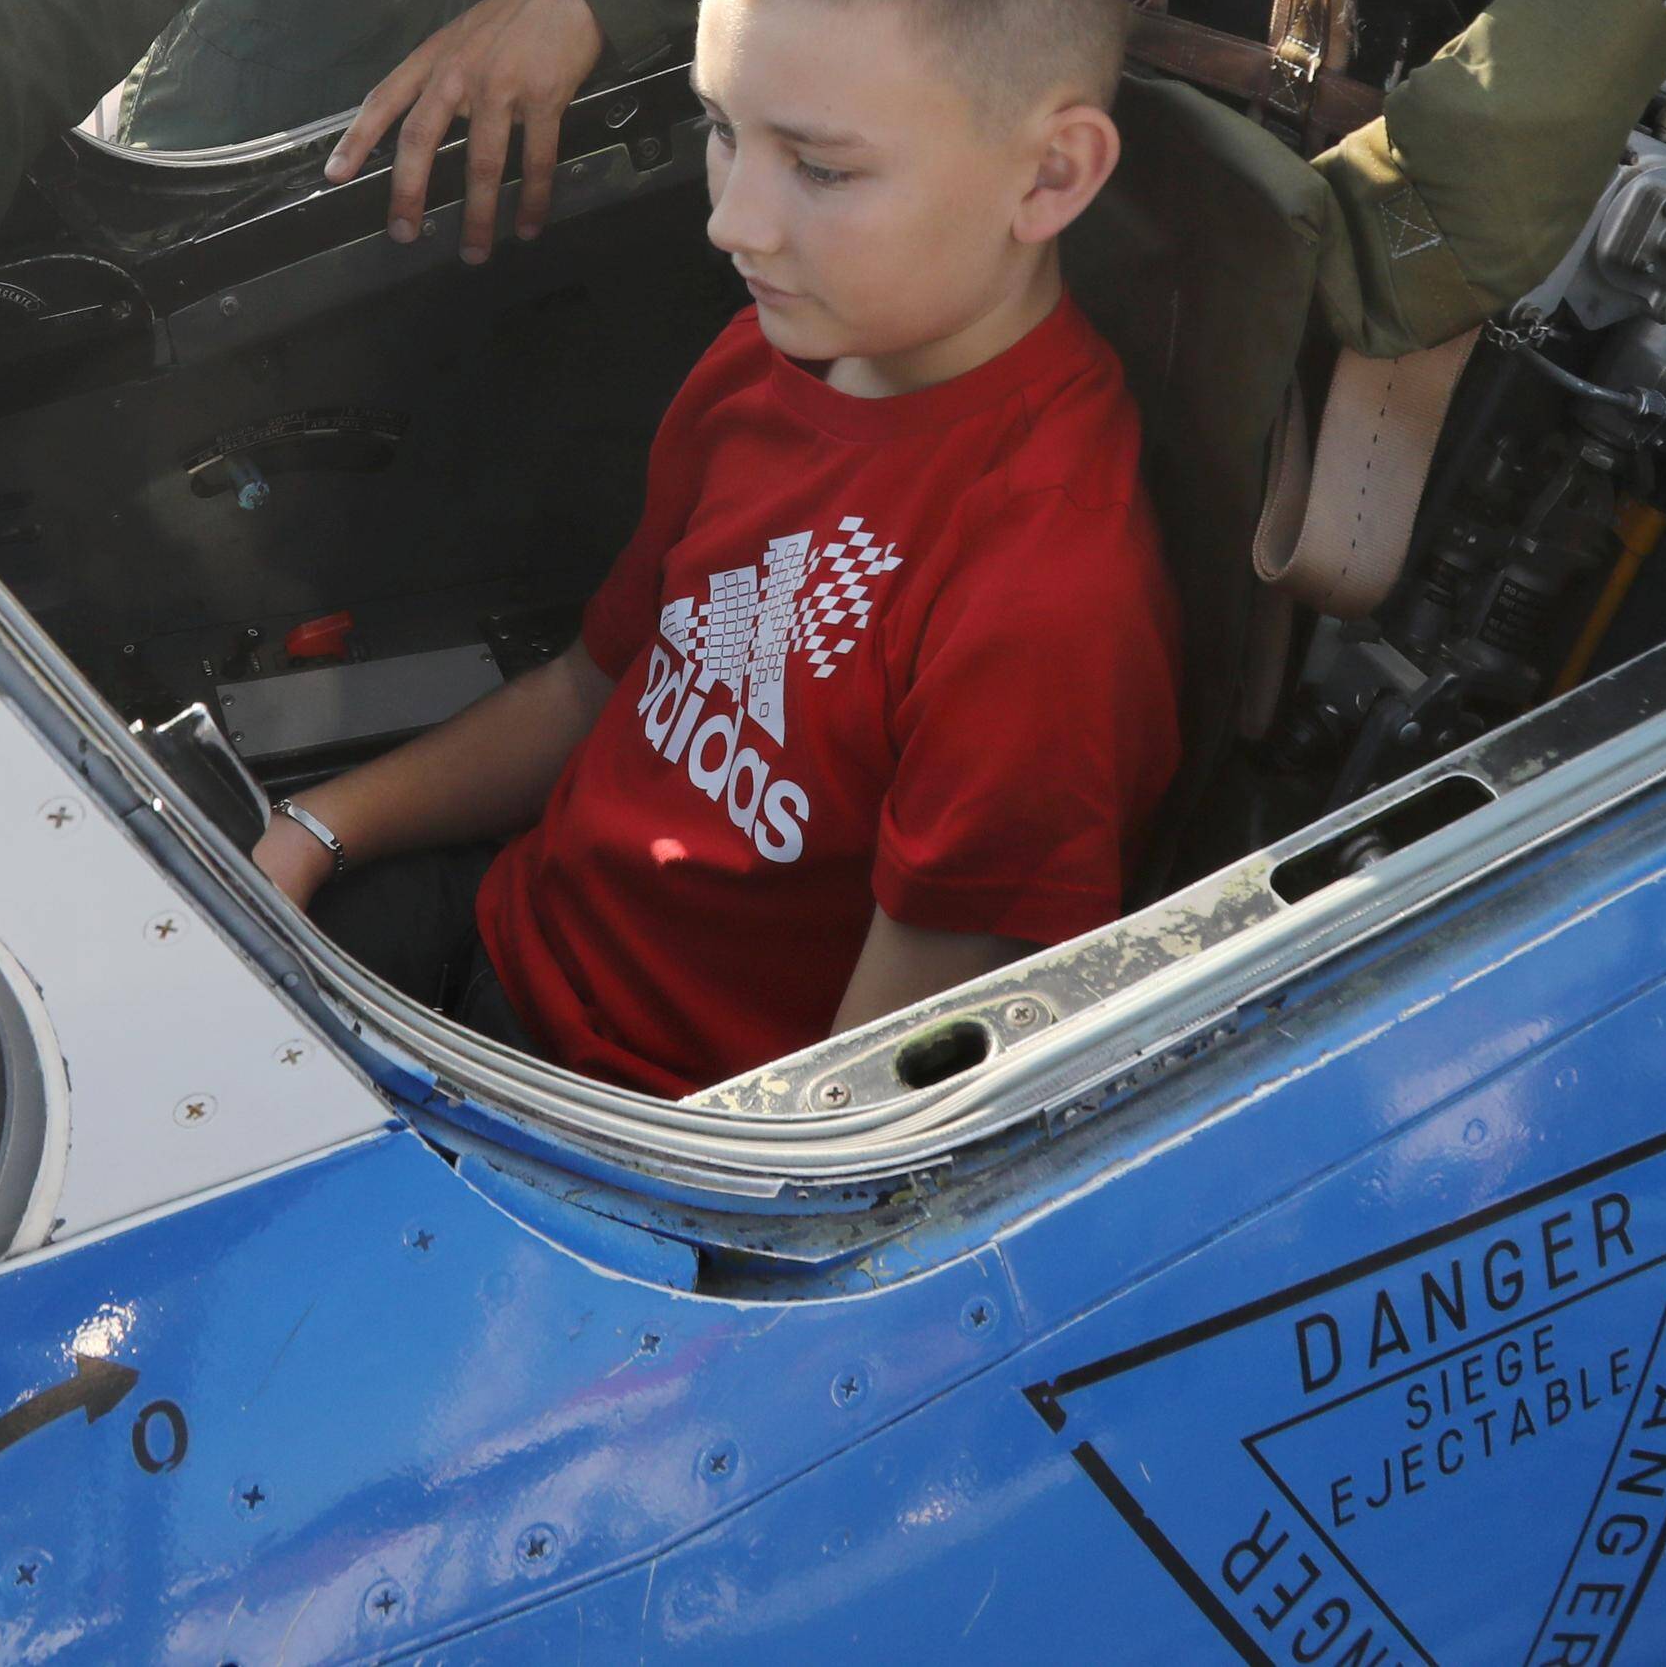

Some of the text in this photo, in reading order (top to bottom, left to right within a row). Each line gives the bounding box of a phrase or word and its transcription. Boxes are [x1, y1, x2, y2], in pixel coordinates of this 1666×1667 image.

[638, 645, 810, 863] adidas
[1294, 1191, 1636, 1395] DANGER
[1405, 1324, 1559, 1429] SIEGE
[1331, 1346, 1633, 1529] EJECTABLE
